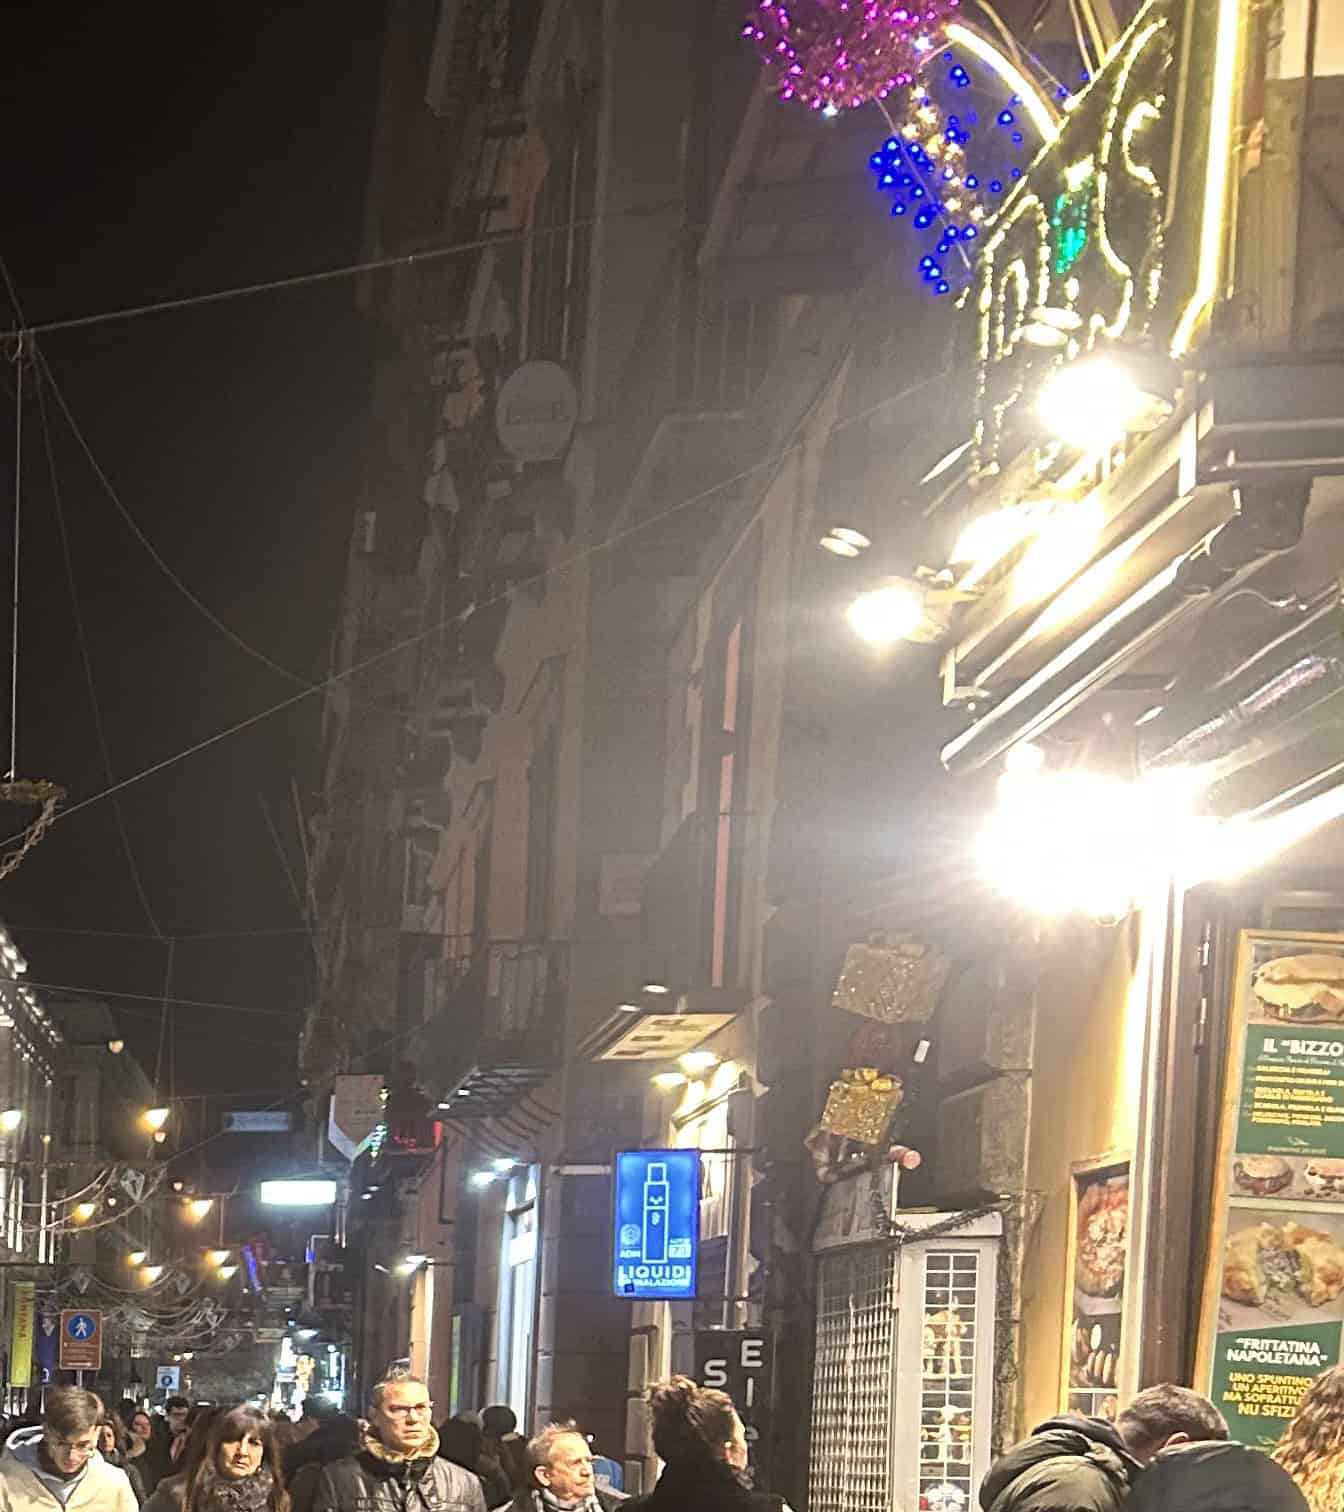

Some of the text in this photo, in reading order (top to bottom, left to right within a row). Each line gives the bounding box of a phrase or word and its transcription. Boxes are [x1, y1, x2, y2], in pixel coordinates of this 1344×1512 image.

[1264, 1038, 1278, 1053] IL
[618, 1265, 692, 1279] LIQUIDI
[1229, 1372, 1255, 1383] UNO
[1223, 1391, 1242, 1401] MA
[1232, 1382, 1309, 1396] UN APERITIVO
[1238, 1403, 1296, 1418] NU SFIZI
